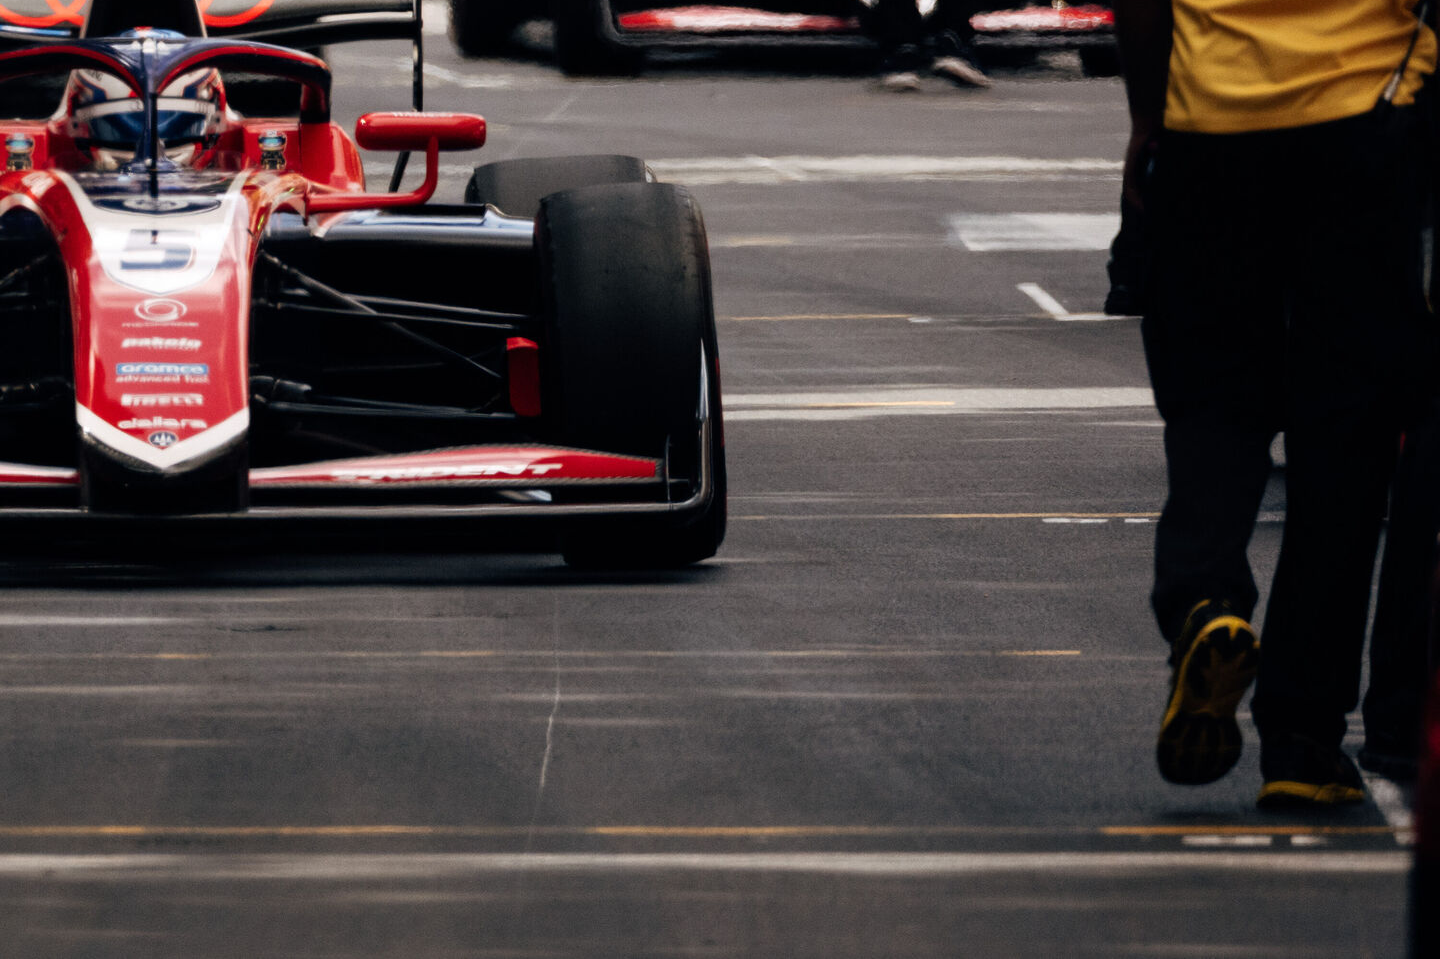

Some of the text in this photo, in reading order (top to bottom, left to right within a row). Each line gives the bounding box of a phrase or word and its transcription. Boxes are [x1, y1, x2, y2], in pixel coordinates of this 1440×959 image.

[121, 364, 205, 374] aramco
[118, 417, 207, 429] dallara
[331, 463, 563, 482] TRIDENT
